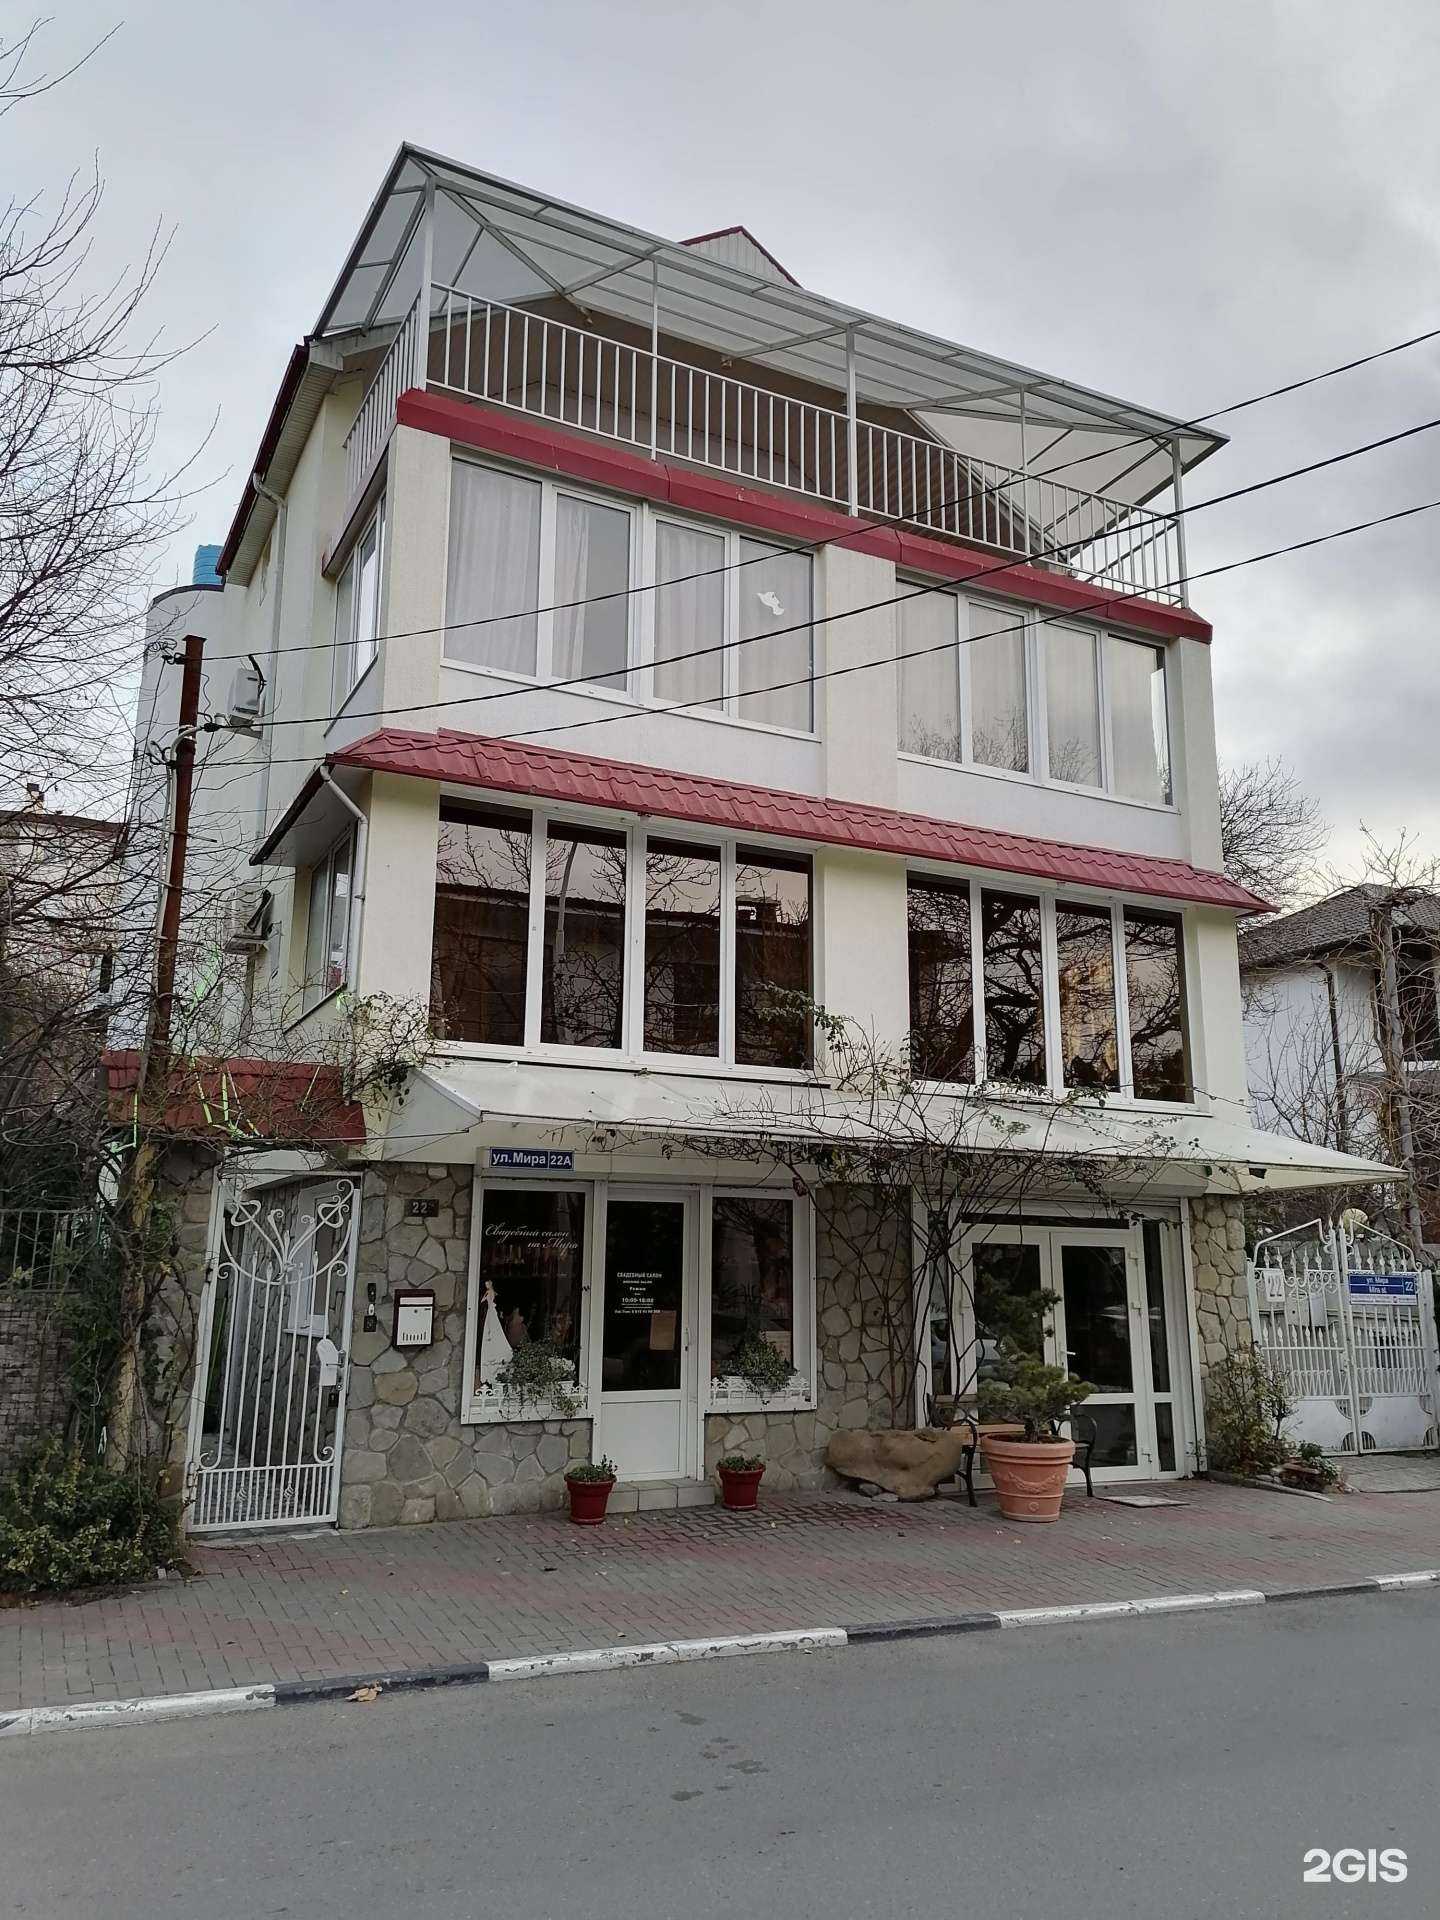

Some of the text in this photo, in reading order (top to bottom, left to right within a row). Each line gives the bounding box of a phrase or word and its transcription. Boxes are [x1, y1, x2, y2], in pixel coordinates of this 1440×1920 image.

[550, 1155, 571, 1166] 22А
[412, 1201, 428, 1213] 22
[1405, 1281, 1414, 1291] 22
